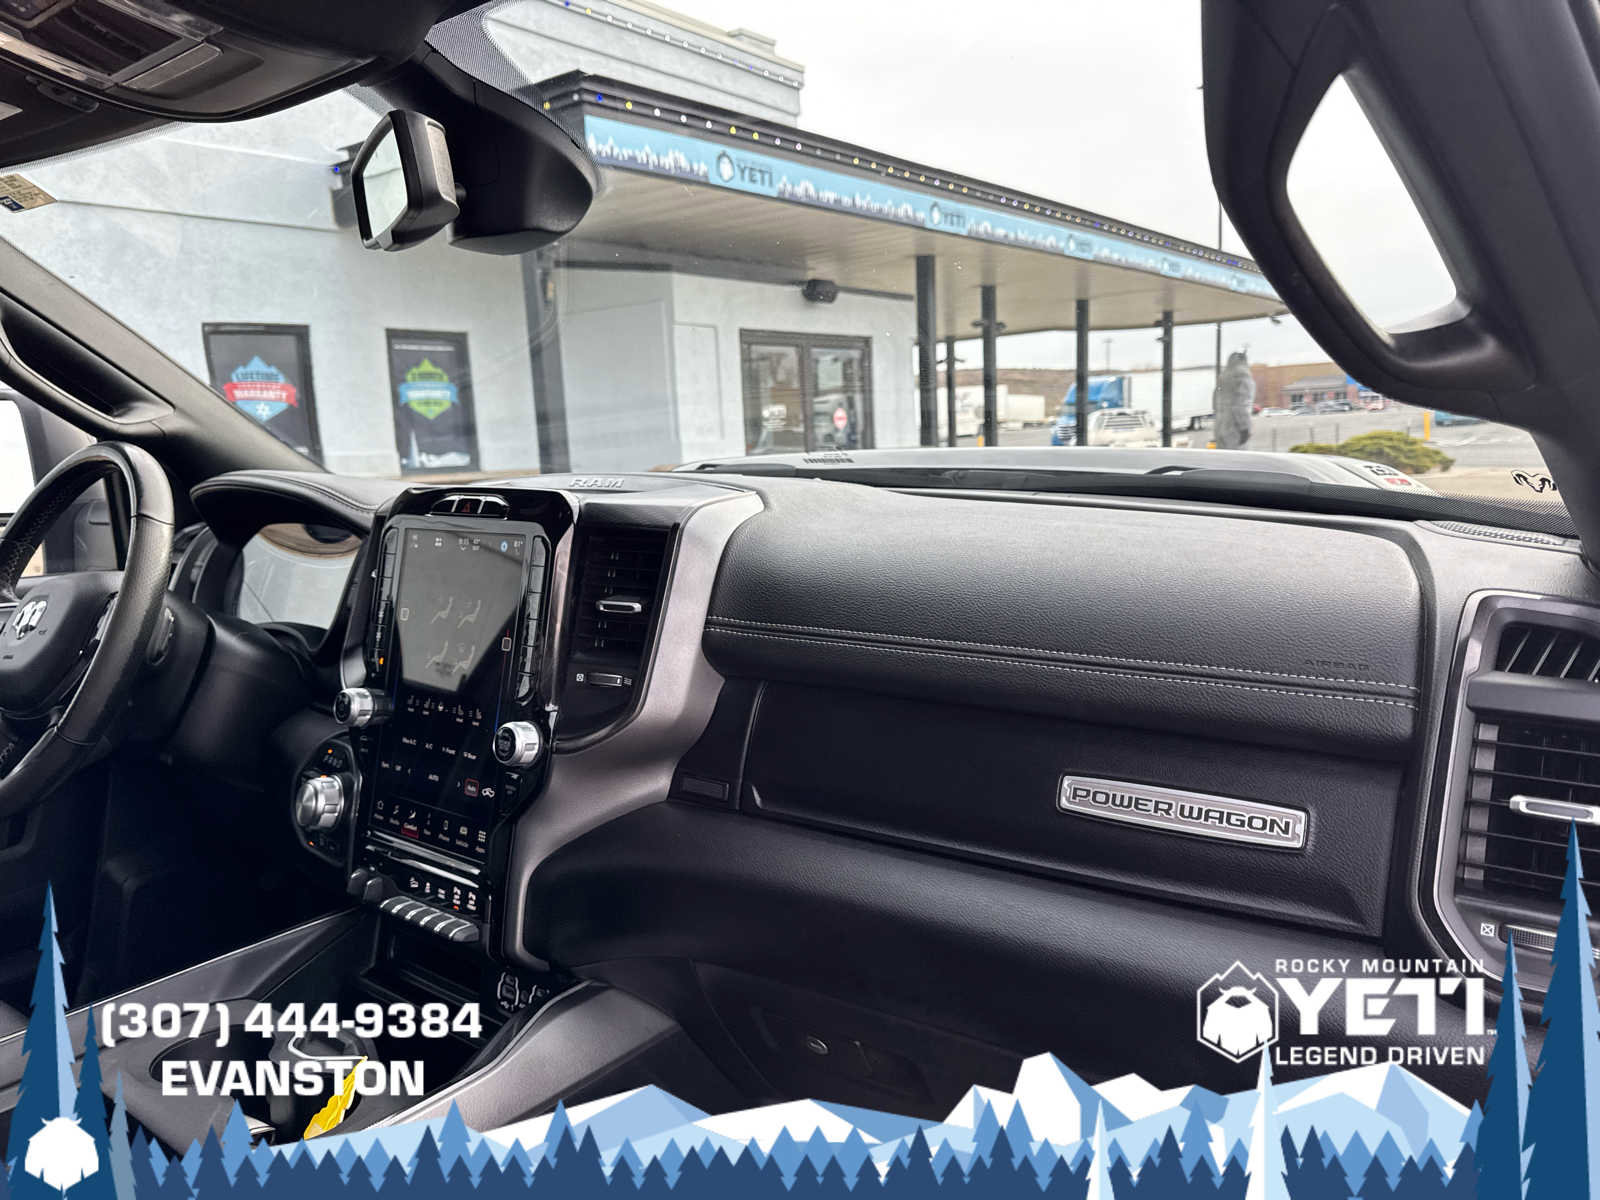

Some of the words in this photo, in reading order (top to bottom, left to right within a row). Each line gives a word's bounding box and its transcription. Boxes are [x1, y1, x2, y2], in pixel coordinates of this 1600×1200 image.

[737, 163, 774, 188] YETI
[569, 477, 625, 489] RAM
[1071, 786, 1173, 818] POWER
[1178, 803, 1291, 837] WAGON
